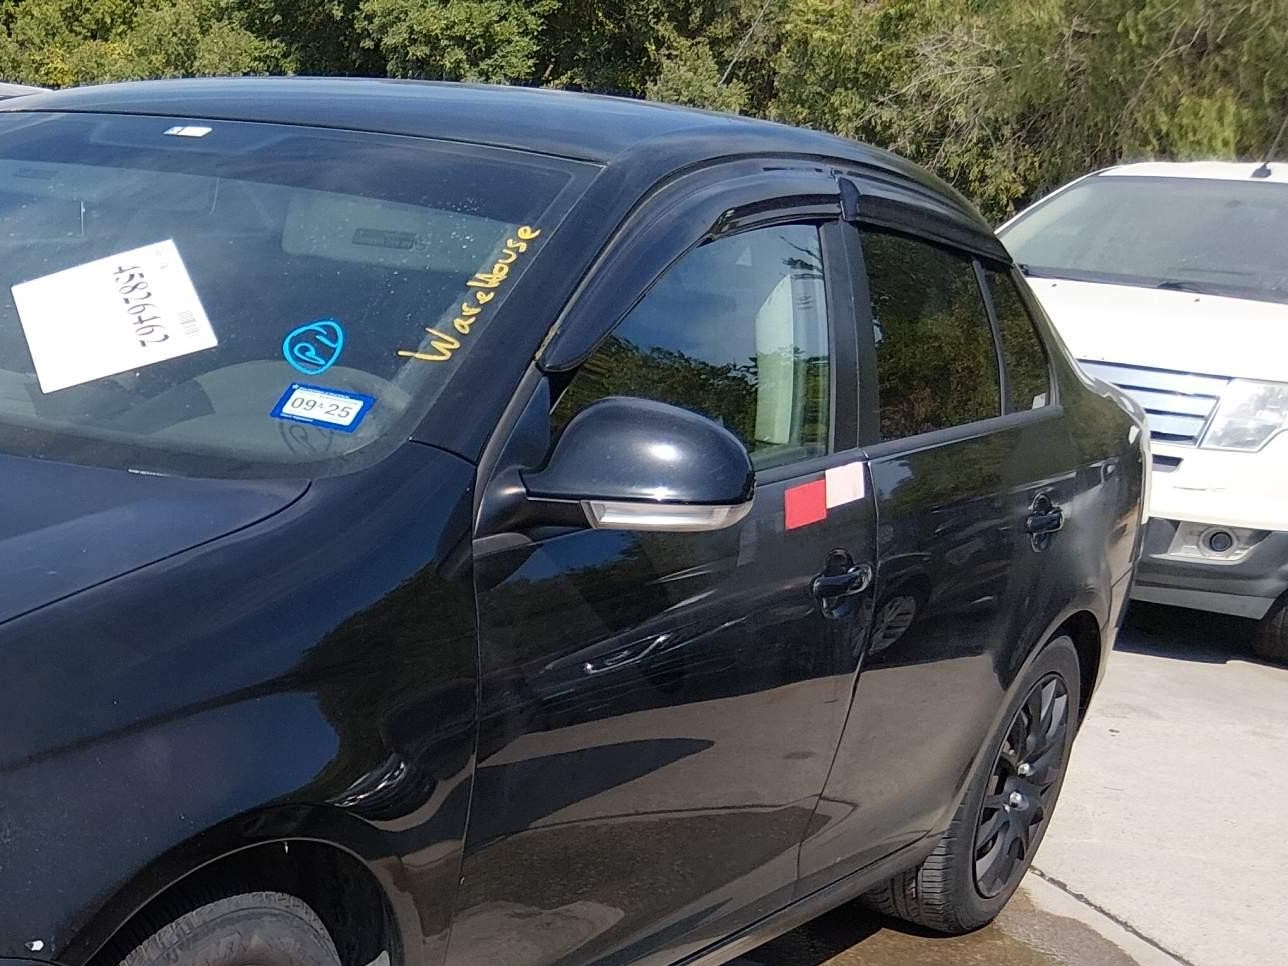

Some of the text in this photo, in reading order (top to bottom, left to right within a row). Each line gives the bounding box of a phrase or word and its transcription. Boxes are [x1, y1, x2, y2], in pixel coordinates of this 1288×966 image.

[113, 265, 170, 348] 45826462
[291, 397, 318, 412] 09
[325, 402, 354, 419] 25
